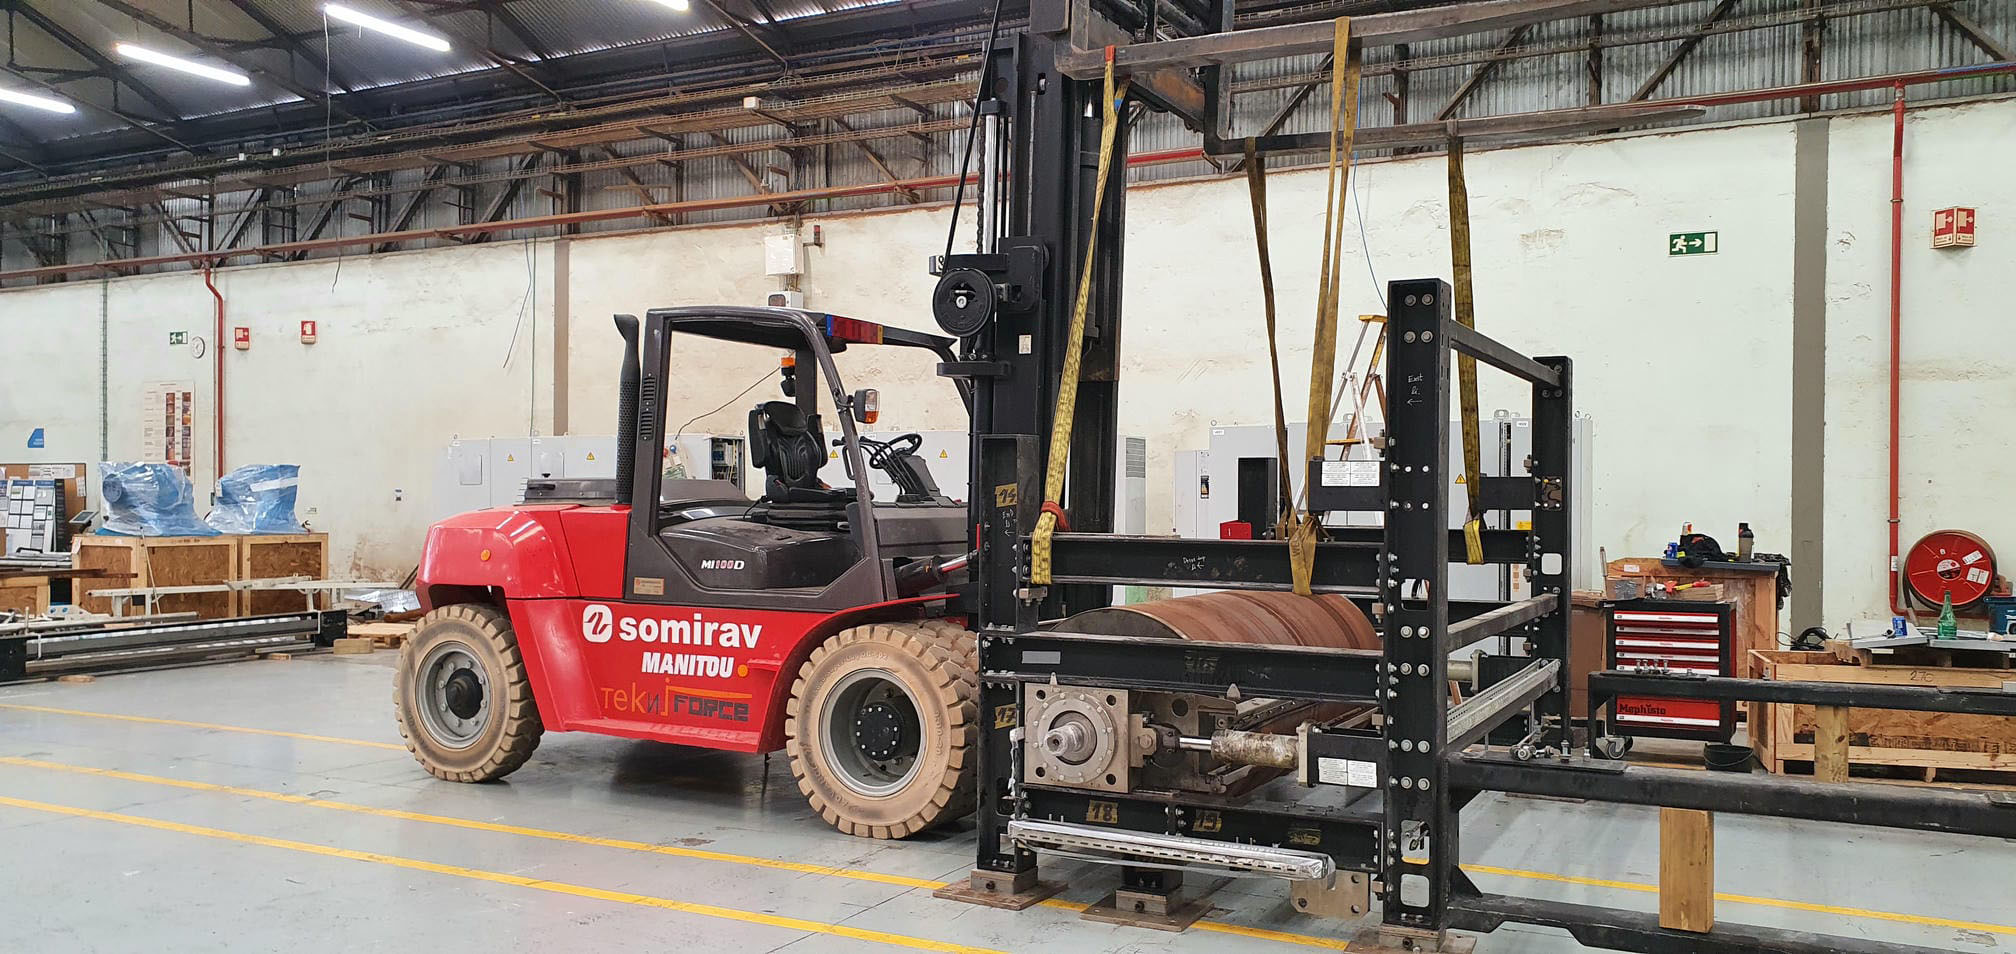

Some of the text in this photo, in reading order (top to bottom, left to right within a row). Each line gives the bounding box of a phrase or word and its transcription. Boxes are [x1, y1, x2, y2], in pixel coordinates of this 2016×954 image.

[701, 559, 745, 570] MI100D
[618, 612, 763, 649] somirav
[641, 651, 735, 678] MANITOU
